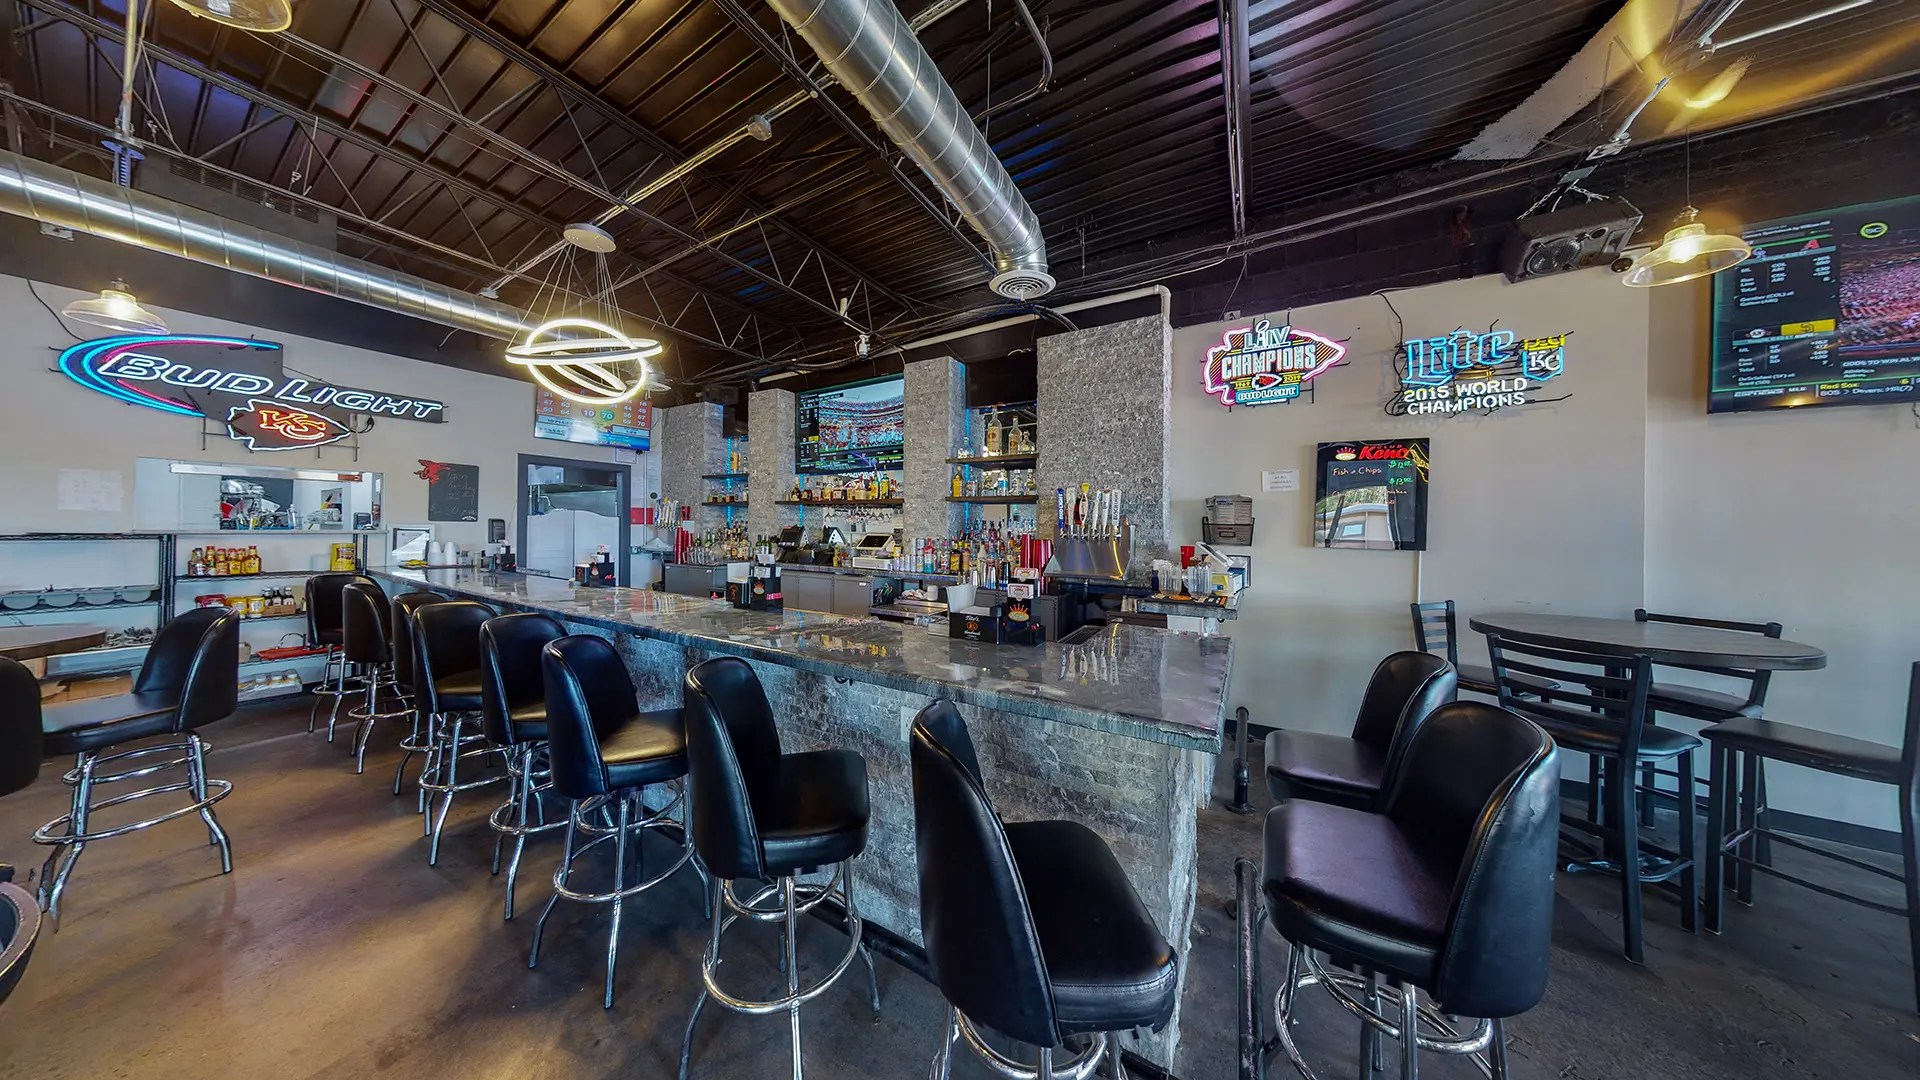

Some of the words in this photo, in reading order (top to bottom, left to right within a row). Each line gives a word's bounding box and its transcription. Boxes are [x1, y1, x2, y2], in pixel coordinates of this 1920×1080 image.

[1221, 344, 1316, 380] CHAMPIONS
[1401, 330, 1514, 386] Lite
[1529, 350, 1560, 371] KC
[98, 352, 273, 395] BUD
[276, 377, 443, 419] LIGHT
[1404, 386, 1450, 403] 2015
[1456, 377, 1528, 397] WORLD
[1820, 389, 1841, 397] BOS
[1407, 391, 1526, 416] CHAMPIONS
[257, 409, 326, 441] KC
[1359, 445, 1409, 460] Keno
[1333, 467, 1349, 476] Fish
[1358, 466, 1382, 475] Chips
